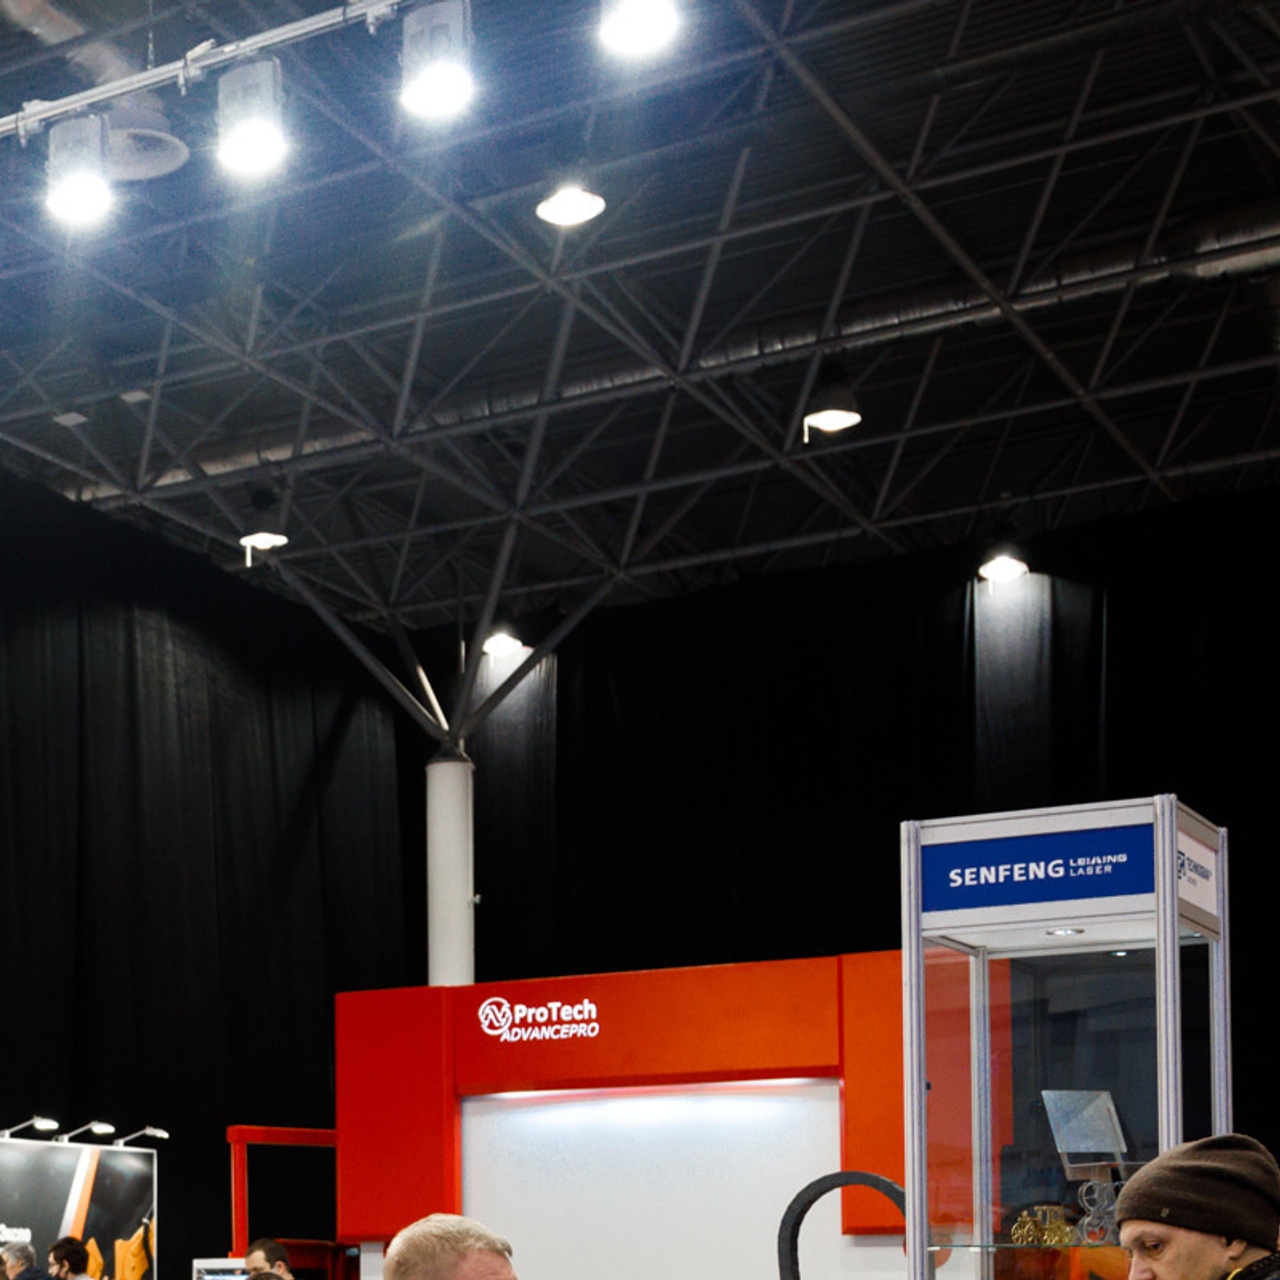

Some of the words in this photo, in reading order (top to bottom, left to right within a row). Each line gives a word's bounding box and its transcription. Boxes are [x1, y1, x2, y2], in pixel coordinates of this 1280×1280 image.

[948, 859, 1065, 887] SENFENG
[1069, 865, 1113, 877] LASER
[513, 998, 598, 1024] ProTech
[500, 1022, 600, 1042] ADVANCEPRO
